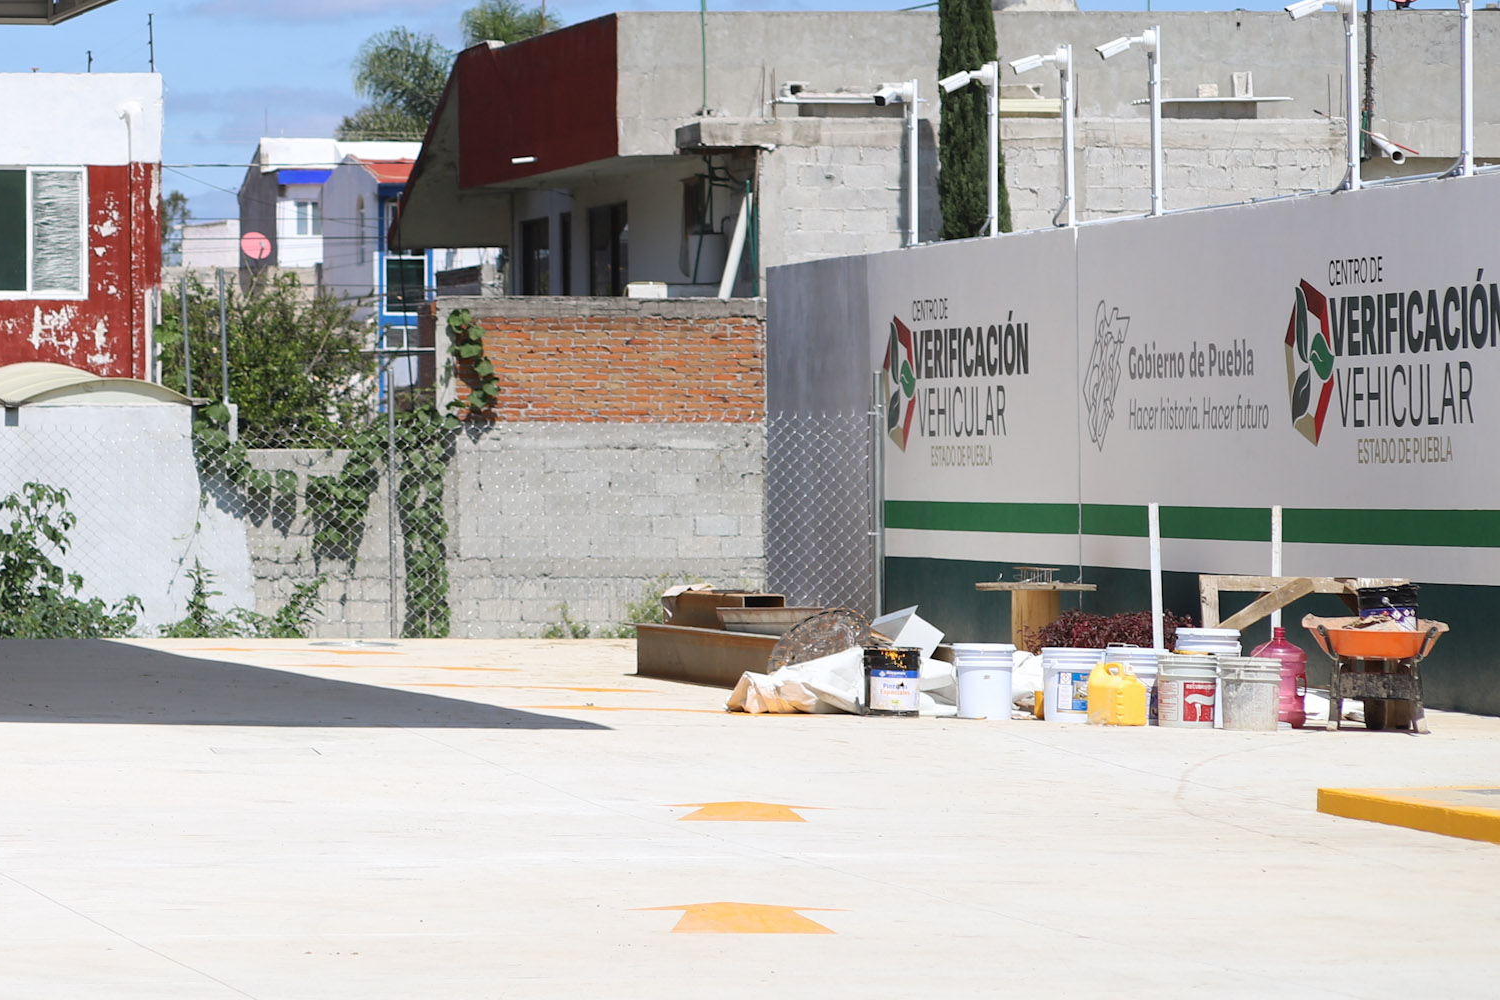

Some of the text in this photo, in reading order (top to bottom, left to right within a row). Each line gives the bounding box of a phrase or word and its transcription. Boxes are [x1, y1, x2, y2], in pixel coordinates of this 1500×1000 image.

[1328, 256, 1383, 286] CENTRO DE
[912, 298, 948, 322] CENTRO DE
[912, 310, 1029, 379] VERIFICACIÓN
[1128, 338, 1254, 380] Gobierno de Puebla
[917, 385, 1007, 437] VEHICULAR
[1129, 393, 1269, 431] Hacer historia. Hacer futuro
[1336, 361, 1474, 428] VEHICULAR
[931, 445, 993, 467] ESTADO DE PUEBLA
[1357, 436, 1453, 464] ESTADO DE PUEBLA
